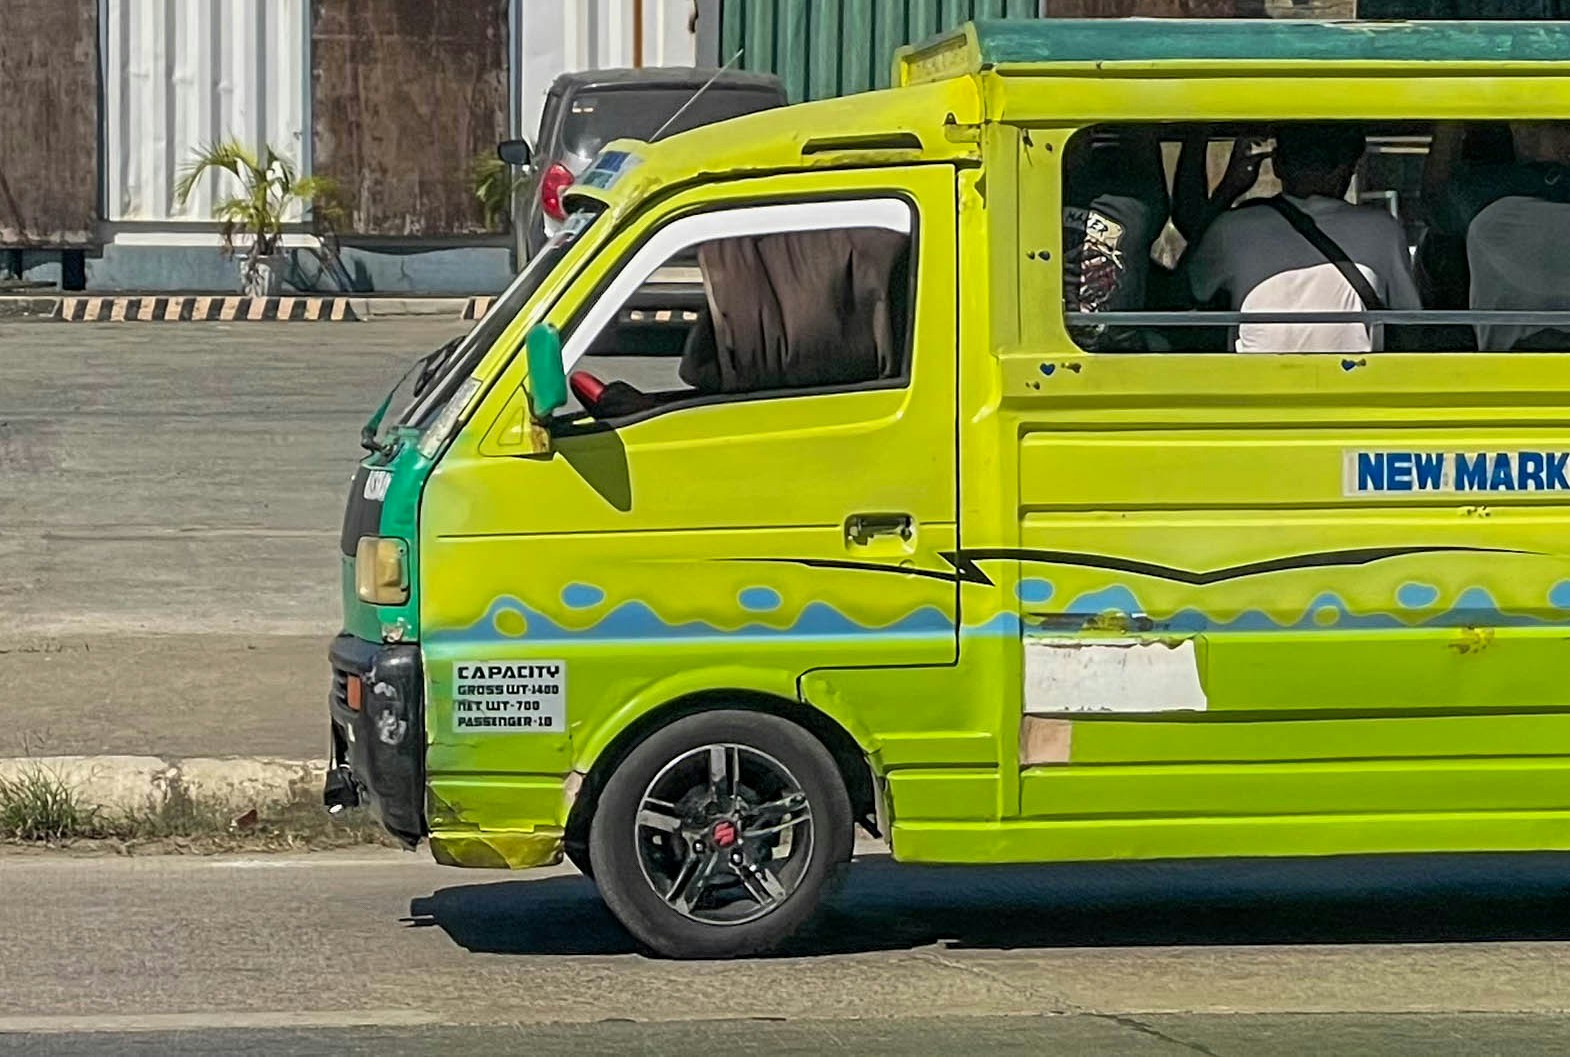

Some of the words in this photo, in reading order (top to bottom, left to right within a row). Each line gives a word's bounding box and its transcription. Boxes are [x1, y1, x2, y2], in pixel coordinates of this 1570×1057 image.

[1358, 452, 1444, 490] NEW
[457, 665, 559, 679] CAPACITY
[457, 684, 503, 695] GROSS
[457, 700, 482, 711] NET
